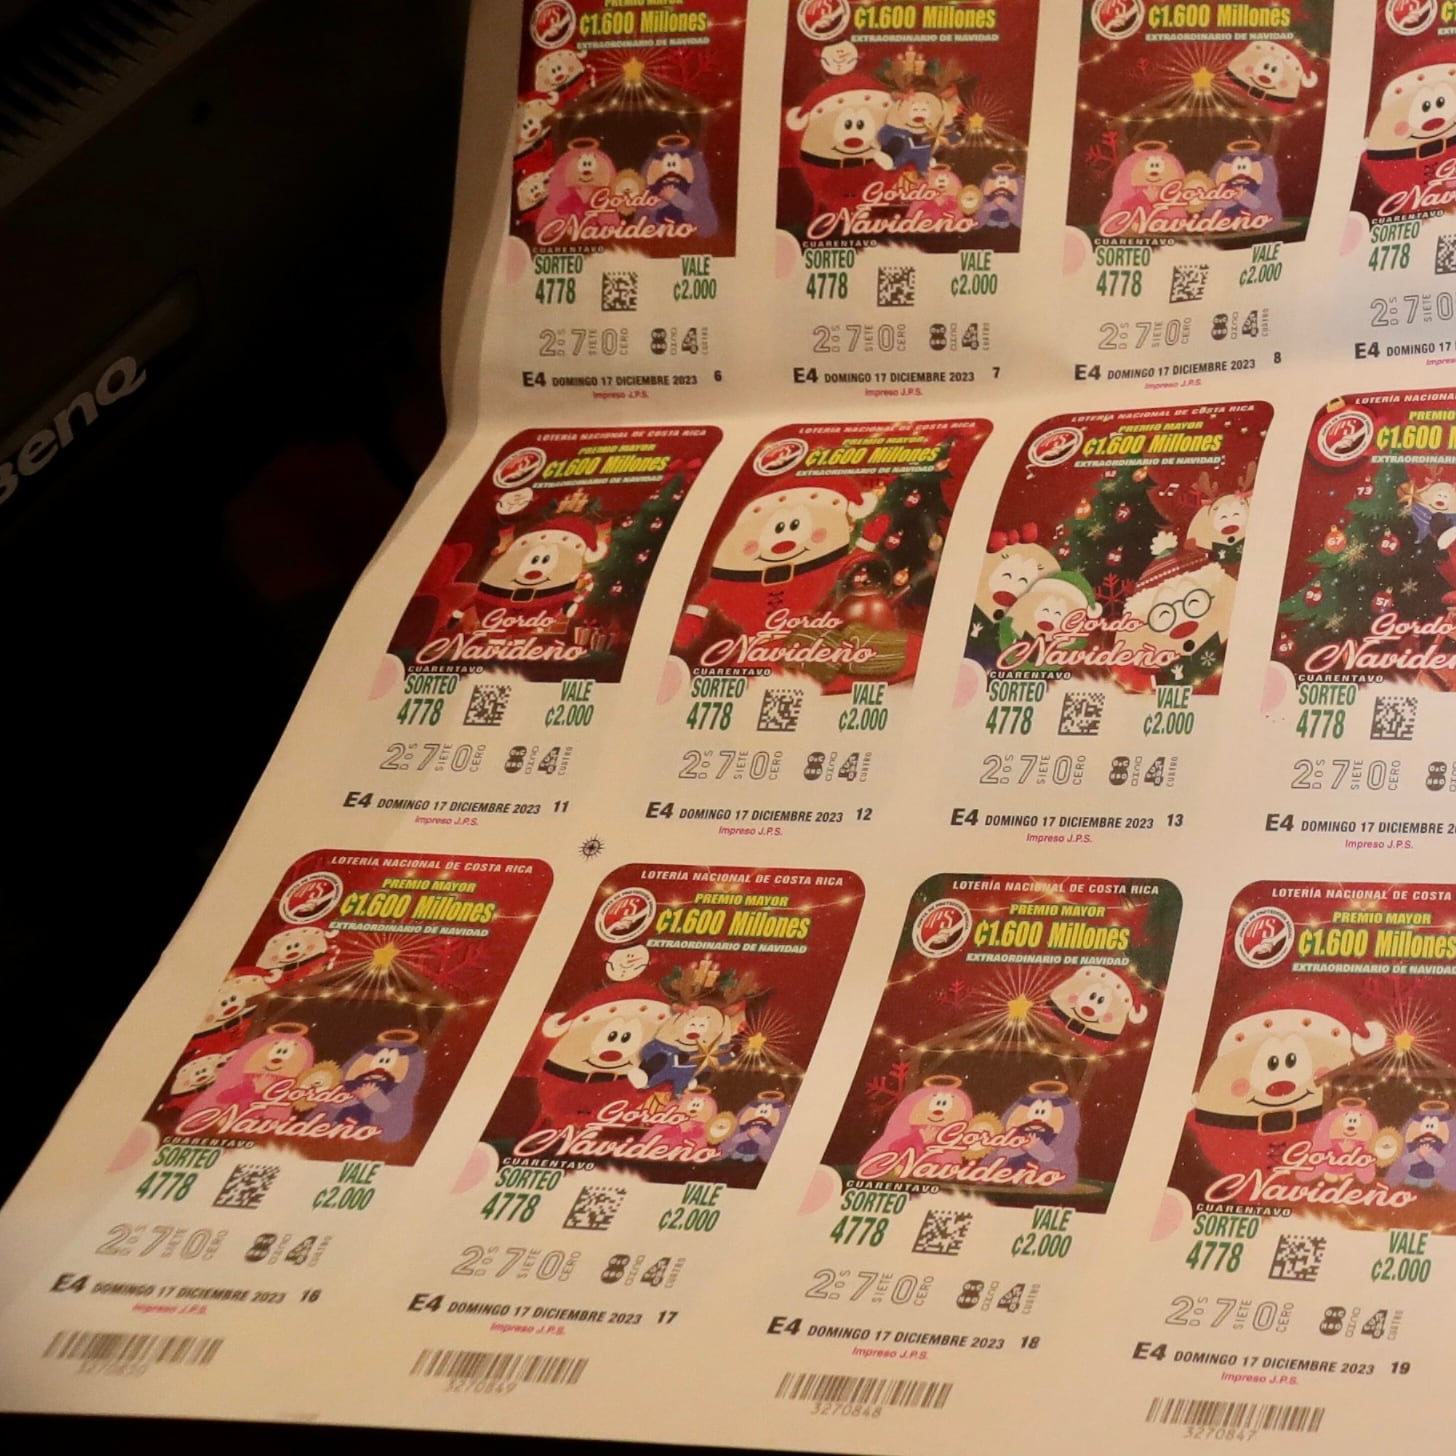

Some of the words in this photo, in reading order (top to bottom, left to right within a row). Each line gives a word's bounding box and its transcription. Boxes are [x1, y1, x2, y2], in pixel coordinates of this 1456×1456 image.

[640, 8, 707, 33] Millones
[1217, 4, 1290, 27] Millones
[865, 445, 944, 463] Millones
[402, 675, 460, 695] SORTEO
[394, 698, 446, 726] 4778
[951, 809, 980, 826] E4
[984, 815, 1038, 826] DOMINGO
[1042, 816, 1056, 827] 17
[1059, 817, 1122, 828] DICIEMBRE
[1125, 818, 1154, 828] 2023
[1168, 814, 1183, 827] 13
[410, 896, 499, 923] Millones
[1292, 963, 1390, 974] EXTRAORDINARIO
[1392, 964, 1407, 973] DE
[839, 1190, 909, 1215] SORTEO
[827, 1215, 891, 1248] 4778
[407, 1294, 446, 1312] E4
[446, 1302, 511, 1316] DOMINGO
[512, 1306, 531, 1317] 17
[531, 1308, 607, 1322] DICIEMBRE
[607, 1313, 644, 1324] 2023
[658, 1311, 678, 1324] 17
